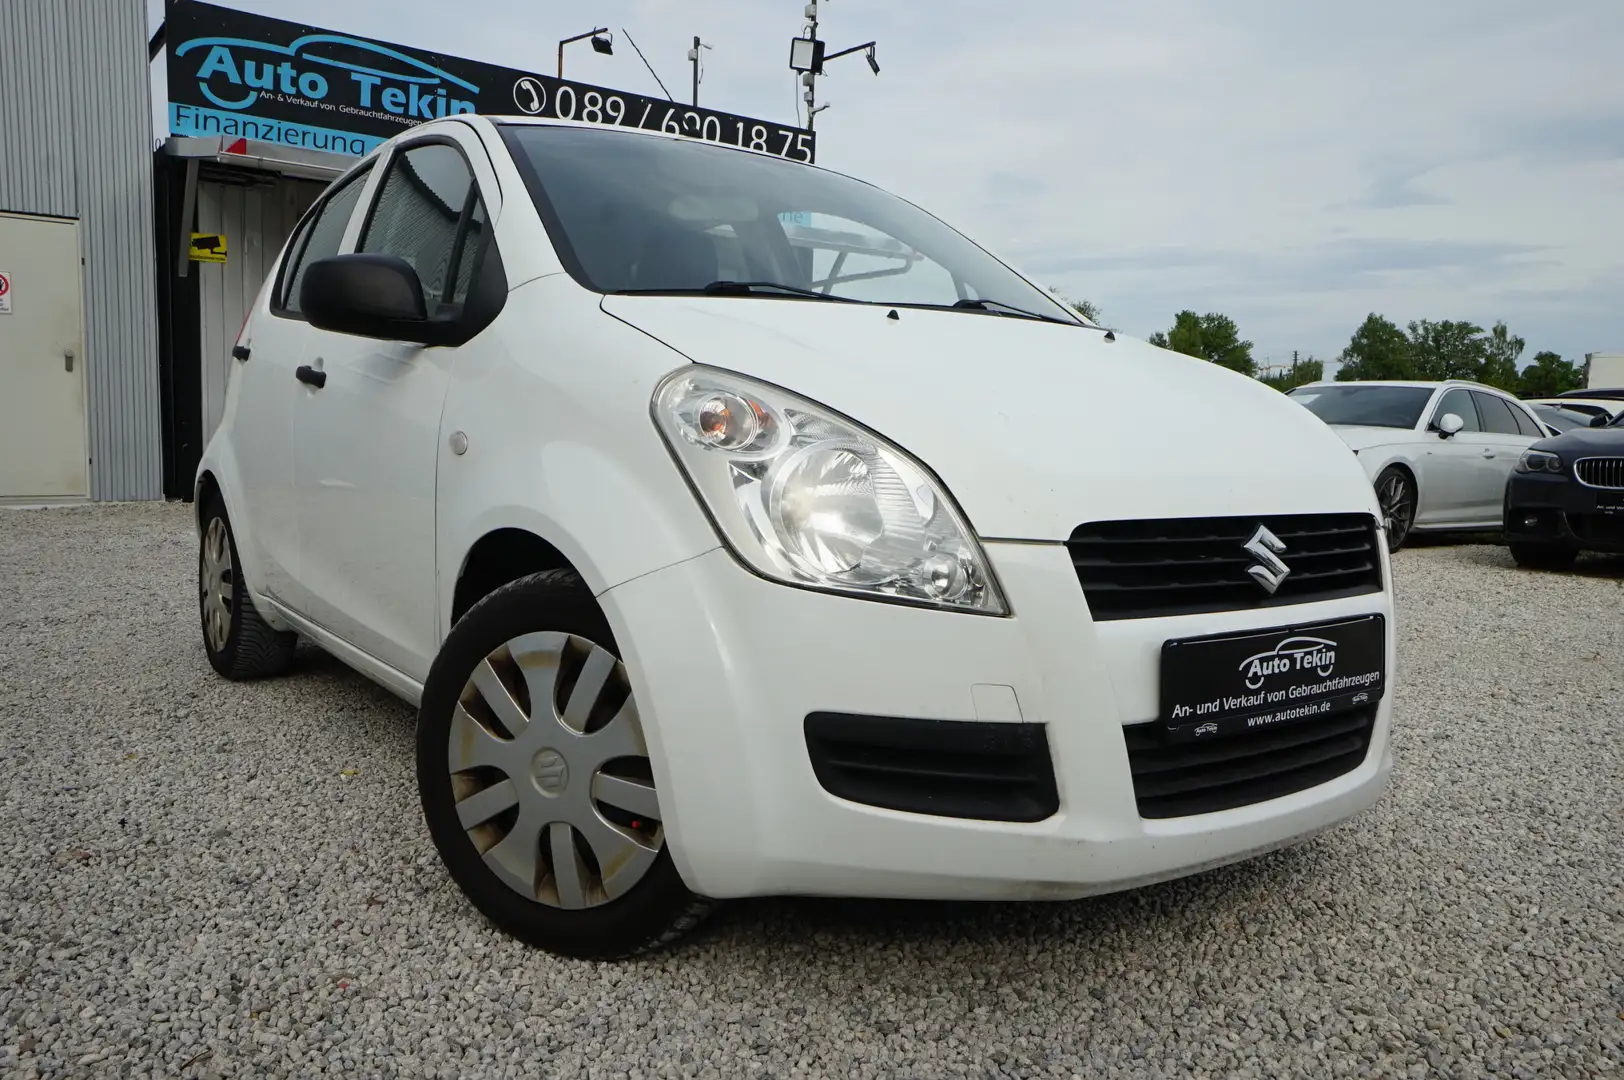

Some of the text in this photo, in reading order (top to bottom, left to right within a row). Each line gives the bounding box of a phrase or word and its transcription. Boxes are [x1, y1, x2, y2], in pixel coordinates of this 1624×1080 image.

[196, 45, 476, 119] Auto Tekin
[176, 104, 365, 158] Finanzierung
[259, 90, 423, 127] An- & Verkauf von Gebrauchtfahrzeugen
[555, 86, 626, 126] 089
[736, 121, 768, 153] 18
[778, 130, 812, 164] 75
[1247, 648, 1336, 678] Auto Tekin
[1172, 670, 1380, 719] An- und Verkauf von Gebrauchtfahrzeugen
[1247, 701, 1331, 727] www.autotekin.de
